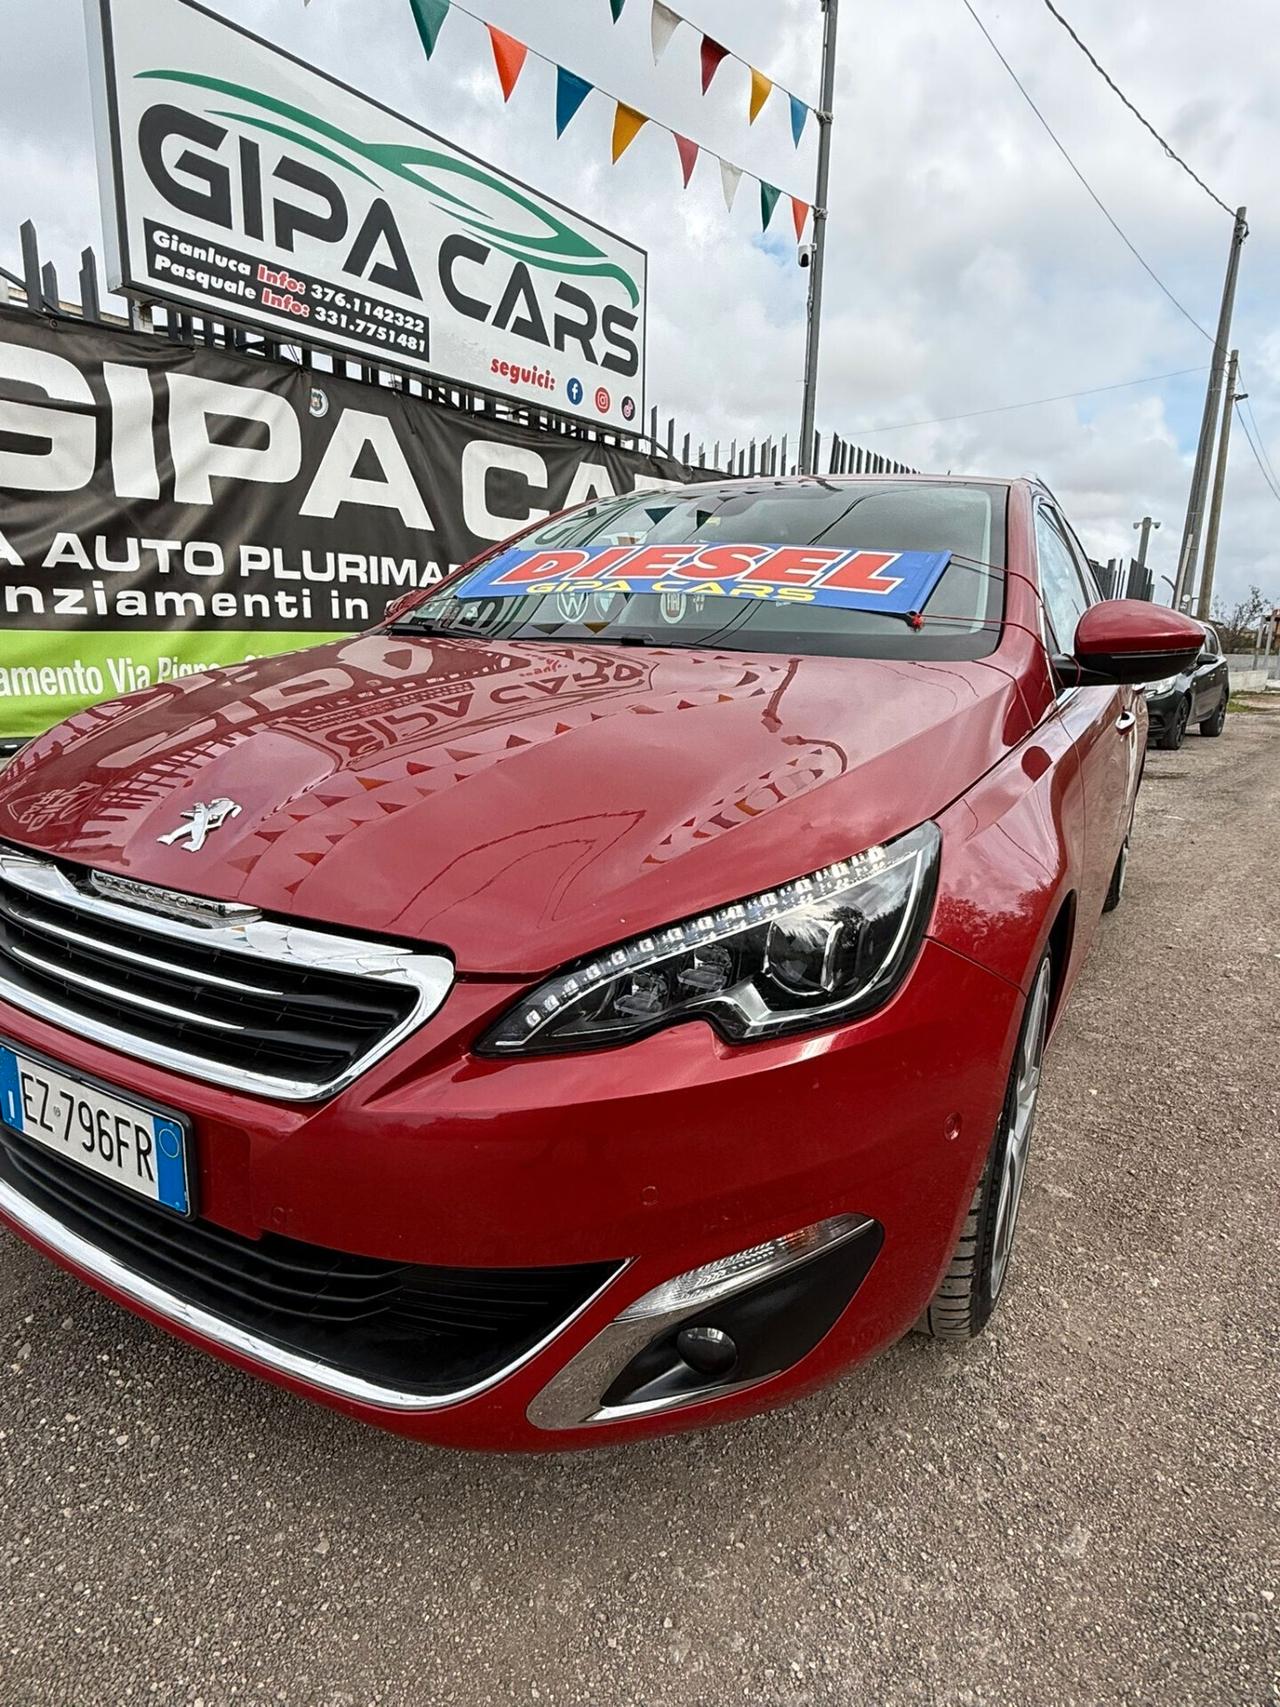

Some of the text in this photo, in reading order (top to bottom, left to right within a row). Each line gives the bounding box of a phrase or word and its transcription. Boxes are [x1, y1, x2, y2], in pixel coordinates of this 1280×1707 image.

[138, 104, 423, 300] GIPA
[152, 229, 425, 334] Gianluca Info: 376.1142322
[154, 254, 426, 354] Pasquale Info: 331.7751481
[438, 233, 639, 377] CARS
[490, 357, 556, 392] seguici:
[42, 532, 225, 576] AUTO
[239, 545, 460, 588] PLURIMA
[490, 545, 904, 593] DIESEL
[6, 580, 368, 620] nziamenti in
[526, 579, 816, 602] GIPA CARS
[107, 657, 150, 693] Via
[21, 1072, 54, 1132] EZ
[59, 1089, 155, 1181] 796FR
